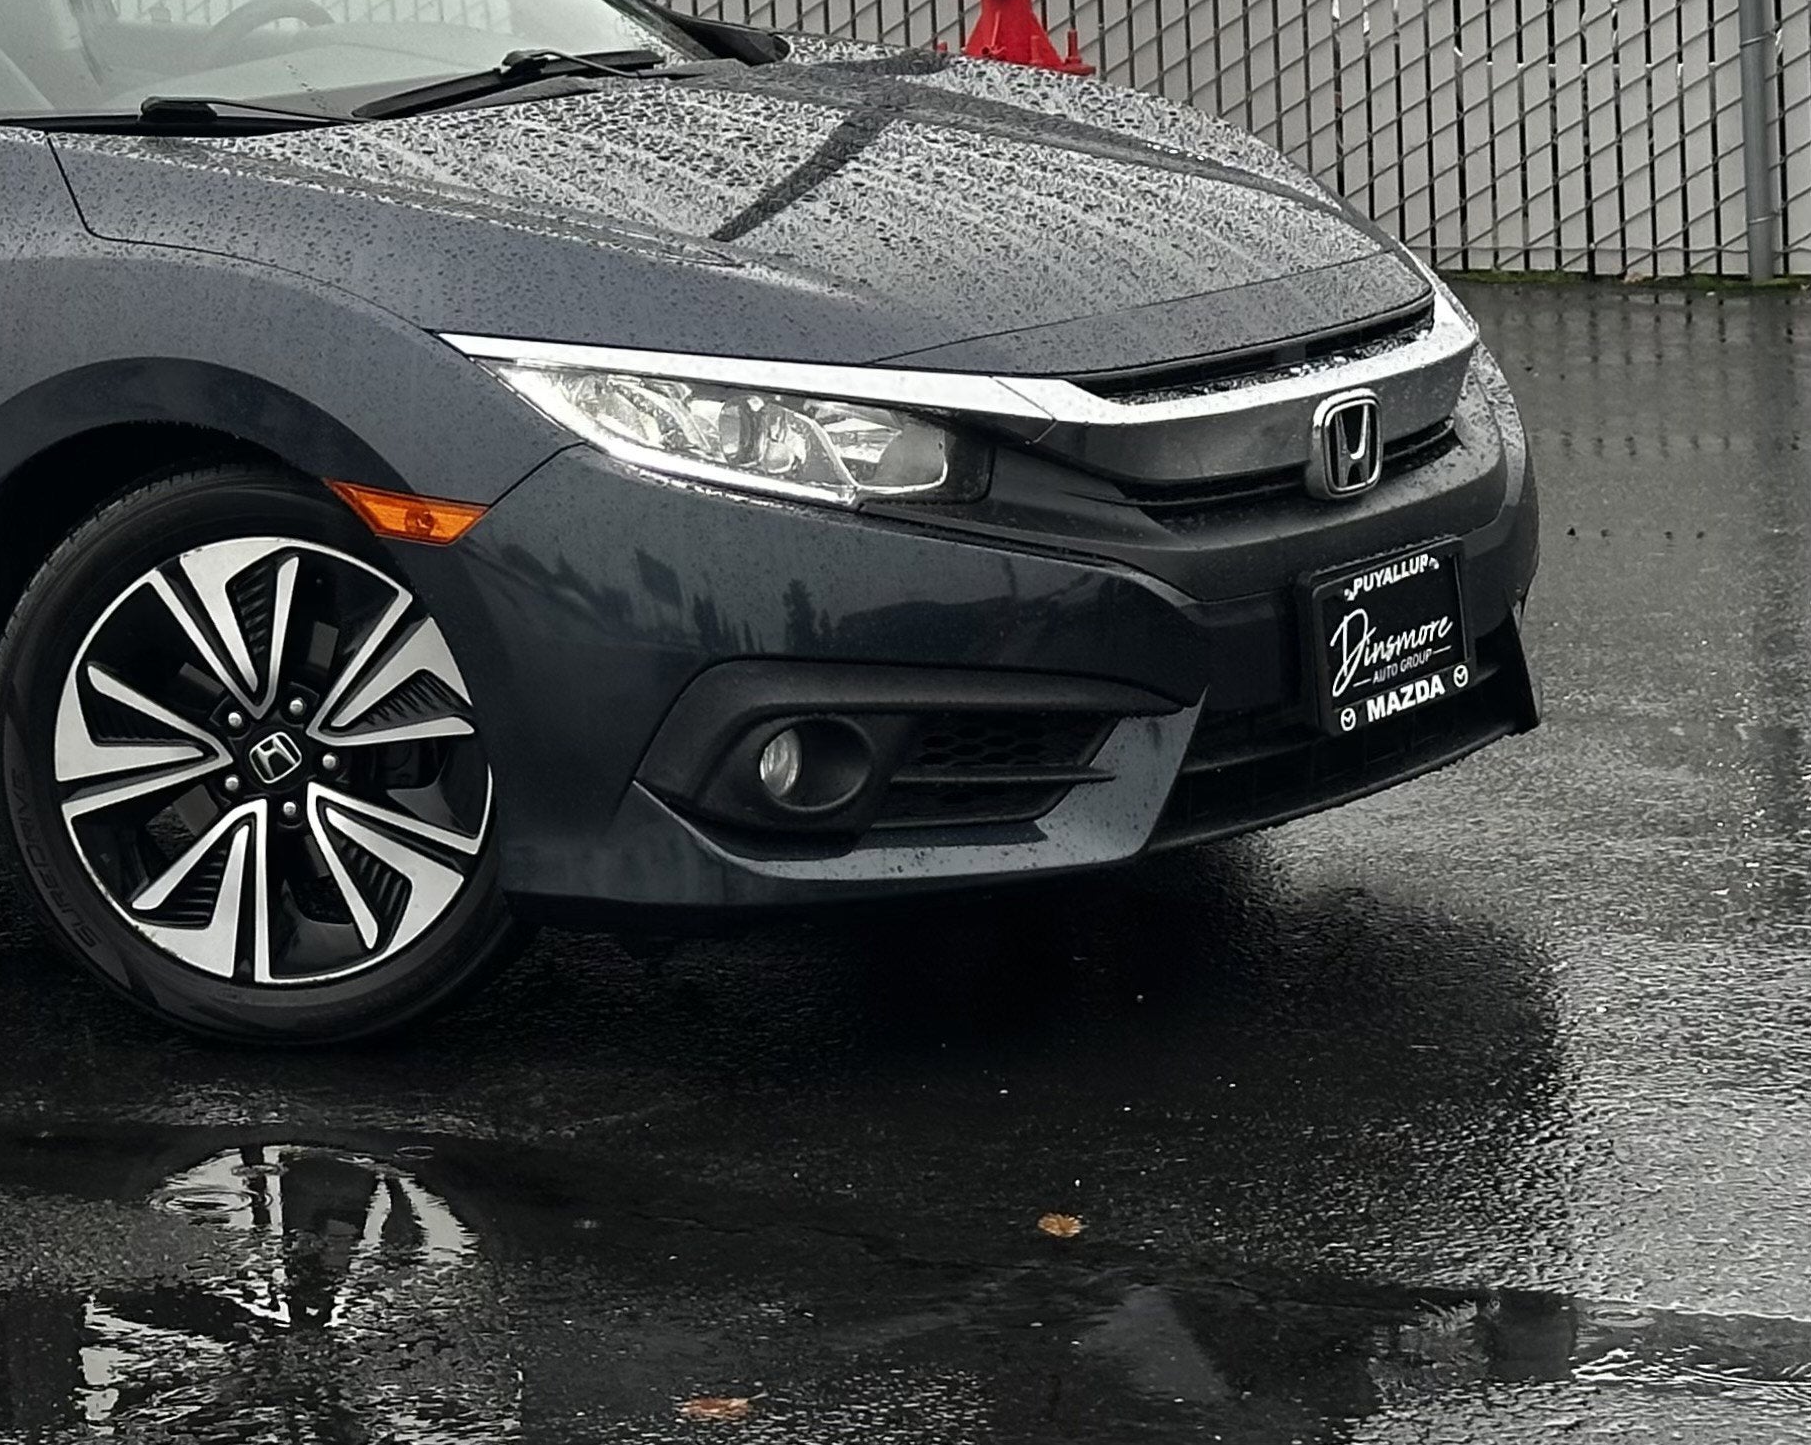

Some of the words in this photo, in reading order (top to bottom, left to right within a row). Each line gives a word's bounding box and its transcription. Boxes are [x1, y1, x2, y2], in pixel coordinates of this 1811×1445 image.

[1353, 554, 1429, 592] PUYALLUP
[1330, 608, 1453, 697] Dinsmore
[1373, 664, 1398, 684] AUTO
[1400, 648, 1432, 672] GROUP
[1367, 675, 1445, 722] MAZDA
